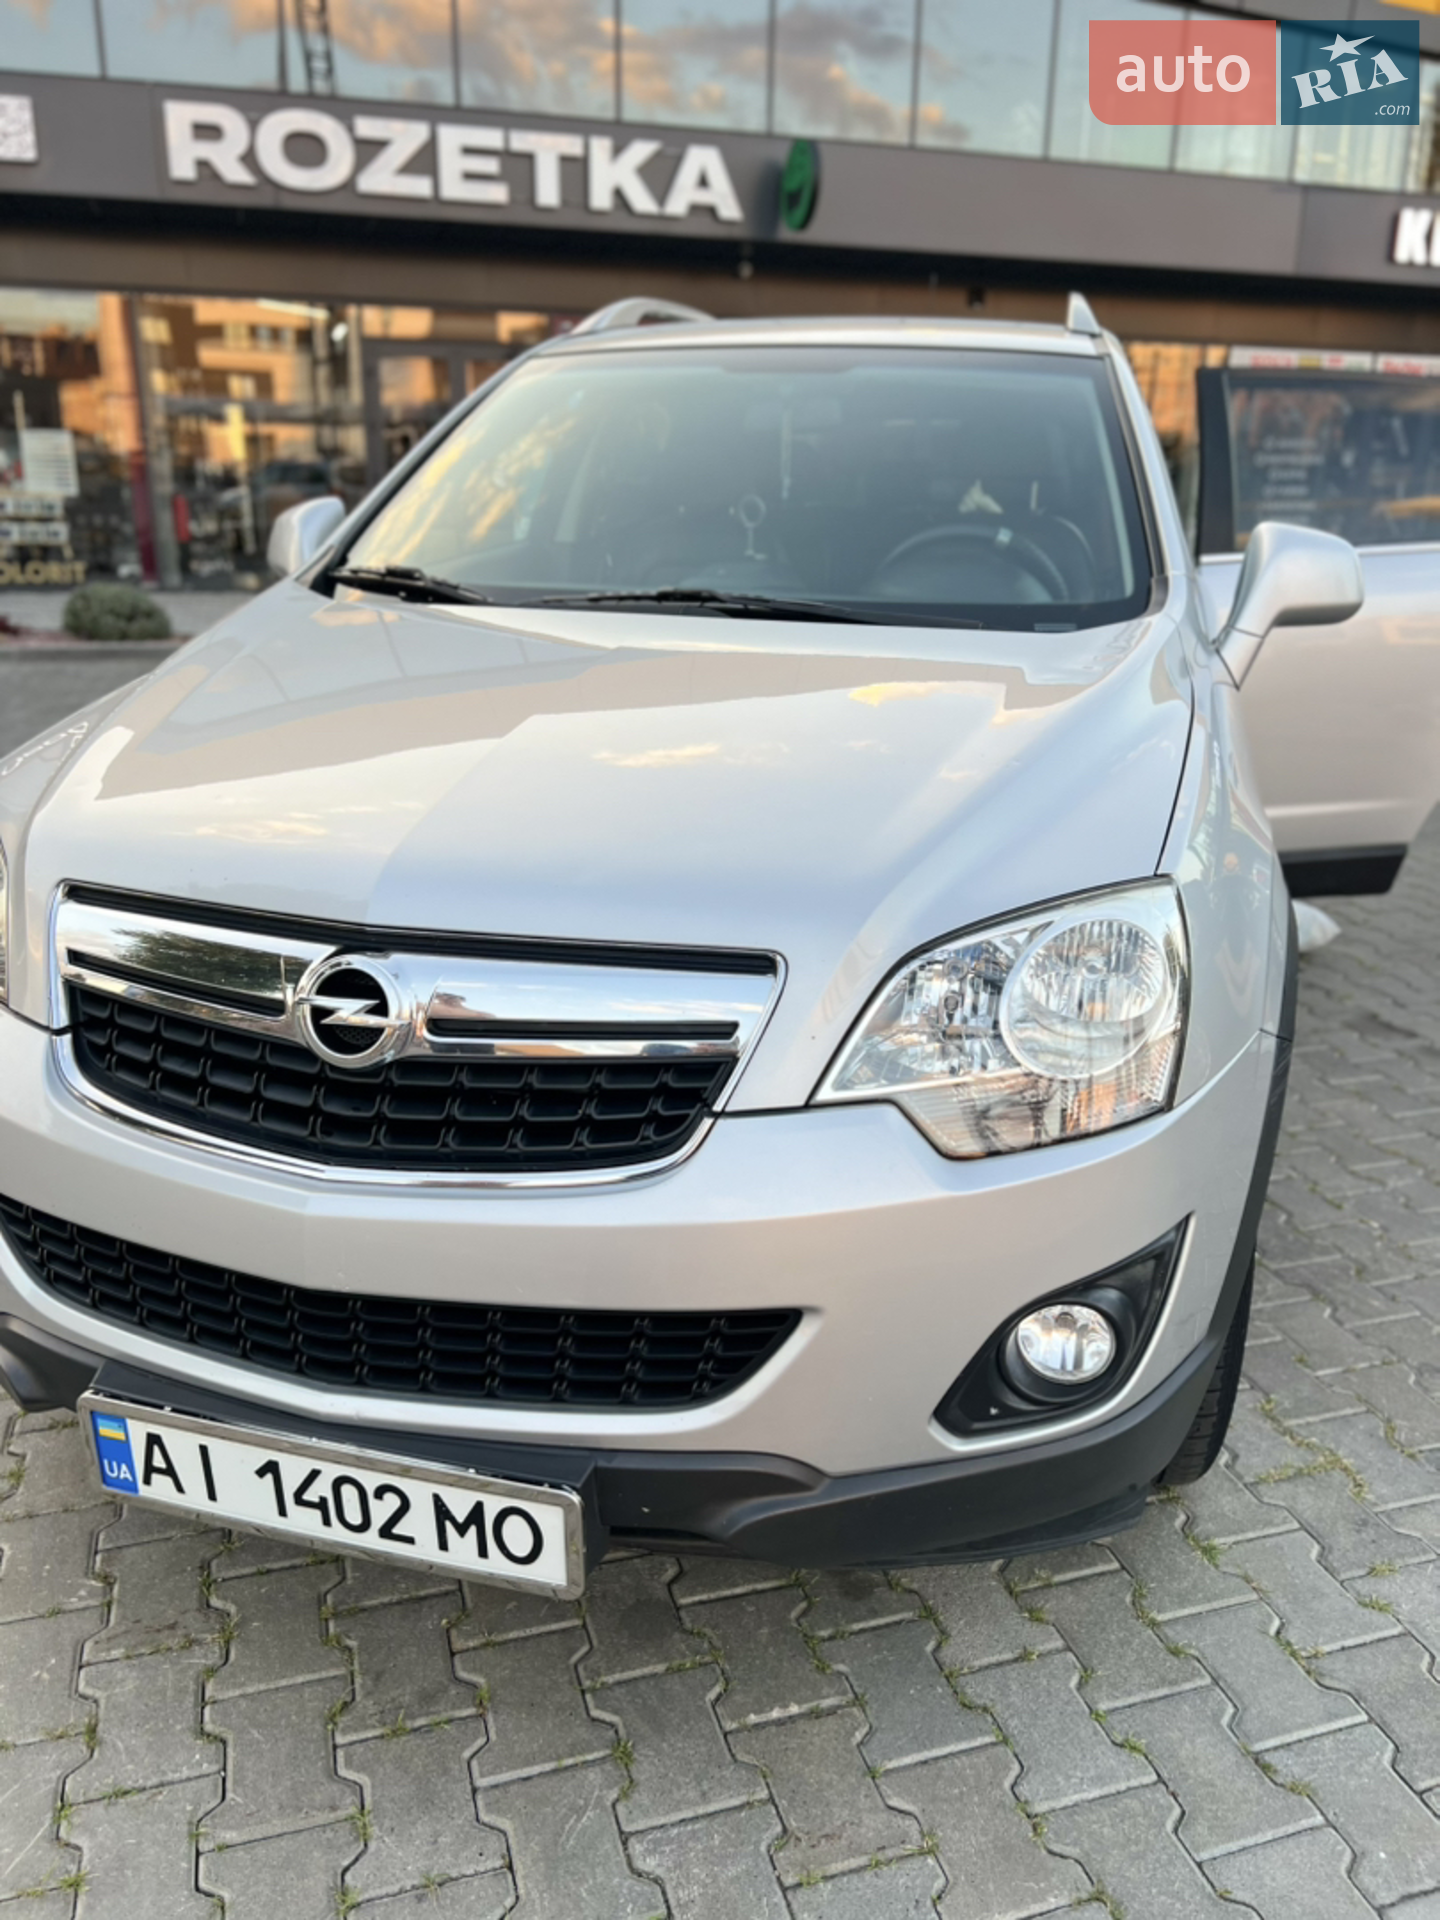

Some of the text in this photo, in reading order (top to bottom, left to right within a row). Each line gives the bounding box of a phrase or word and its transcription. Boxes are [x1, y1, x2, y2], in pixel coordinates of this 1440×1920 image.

[162, 99, 744, 222] ROZETKA
[103, 1458, 133, 1483] UA
[142, 1431, 544, 1566] AI 1402 MO
